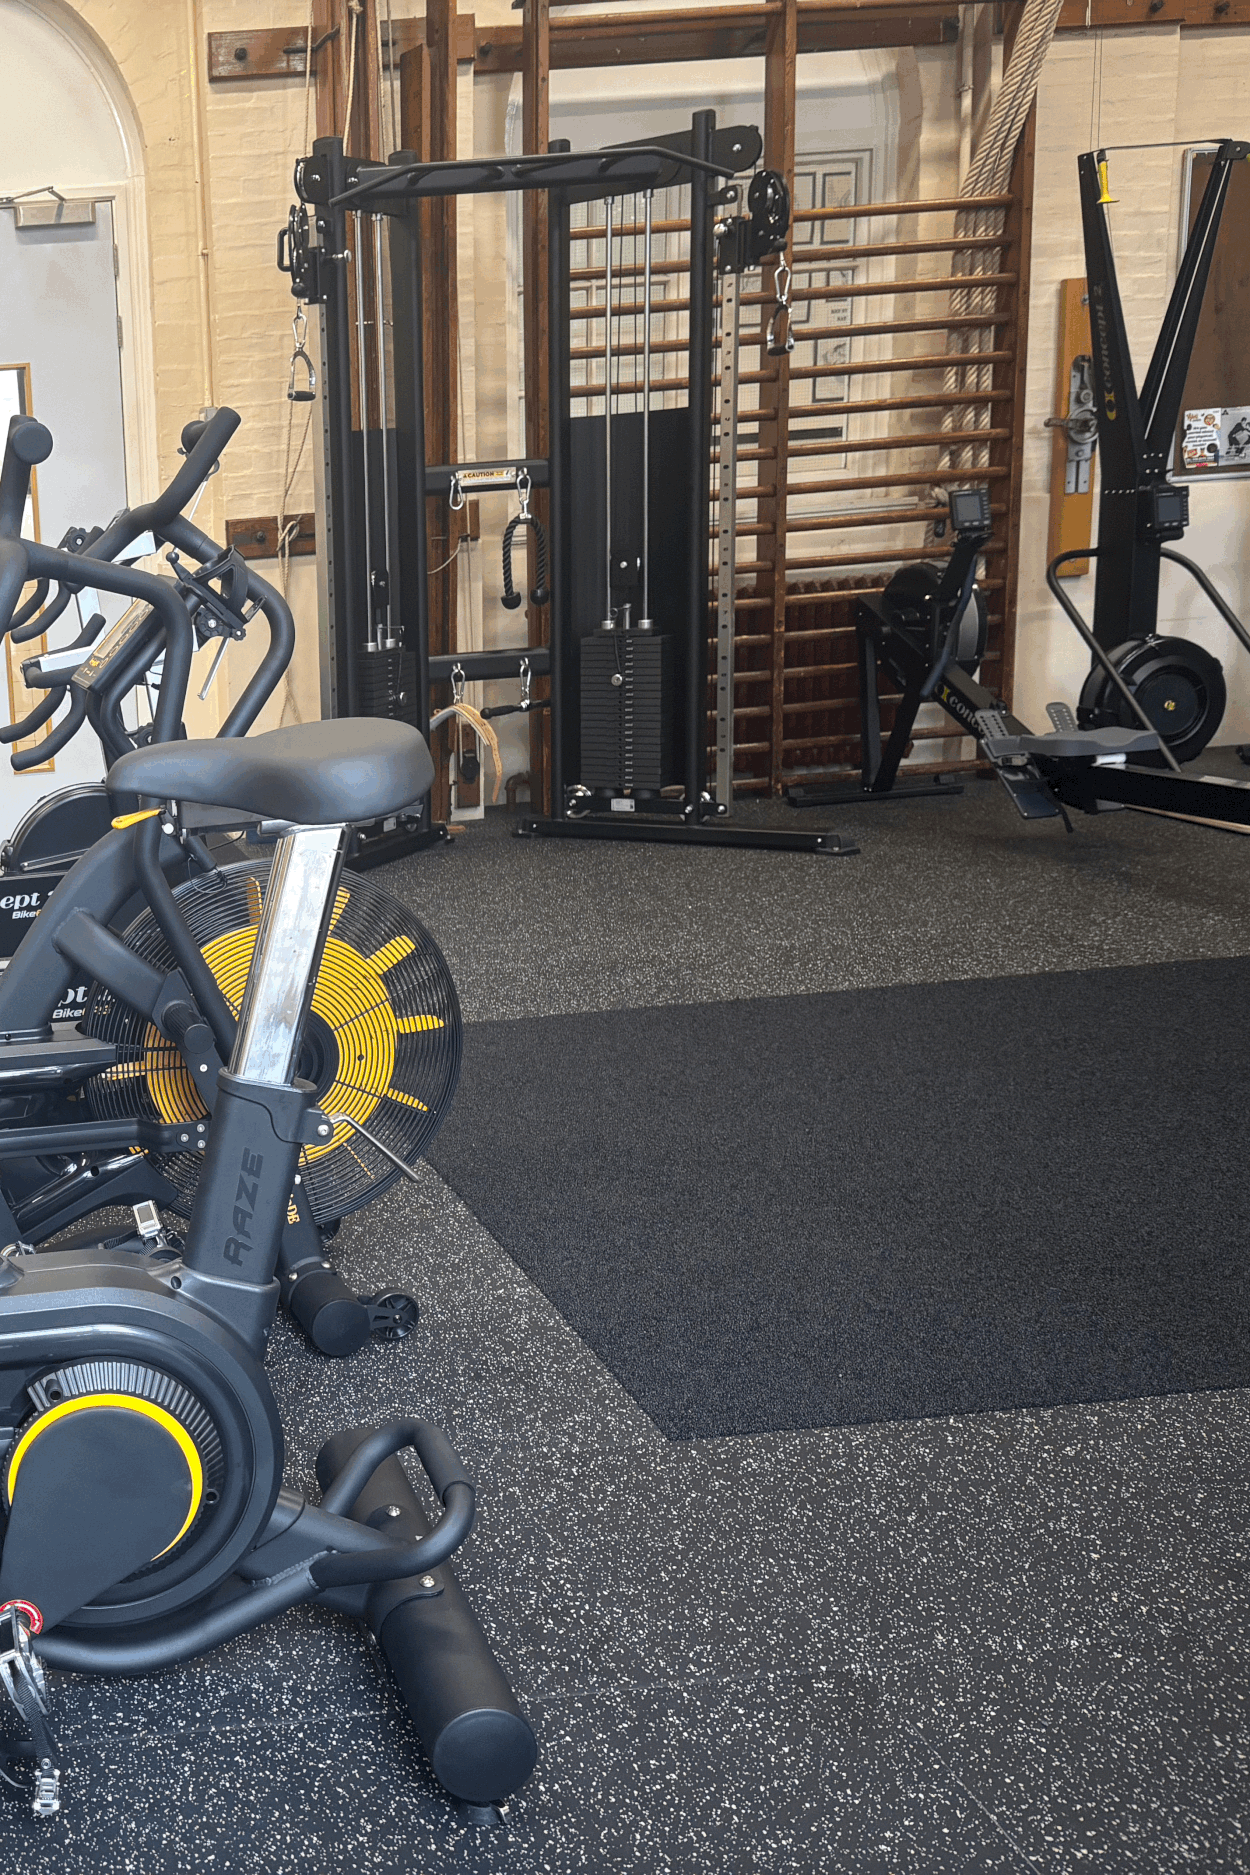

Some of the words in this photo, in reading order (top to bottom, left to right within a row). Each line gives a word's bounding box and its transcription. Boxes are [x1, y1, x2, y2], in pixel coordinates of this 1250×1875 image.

[949, 696, 987, 734] conc
[12, 909, 41, 919] Bike
[223, 1147, 264, 1267] RAZE
